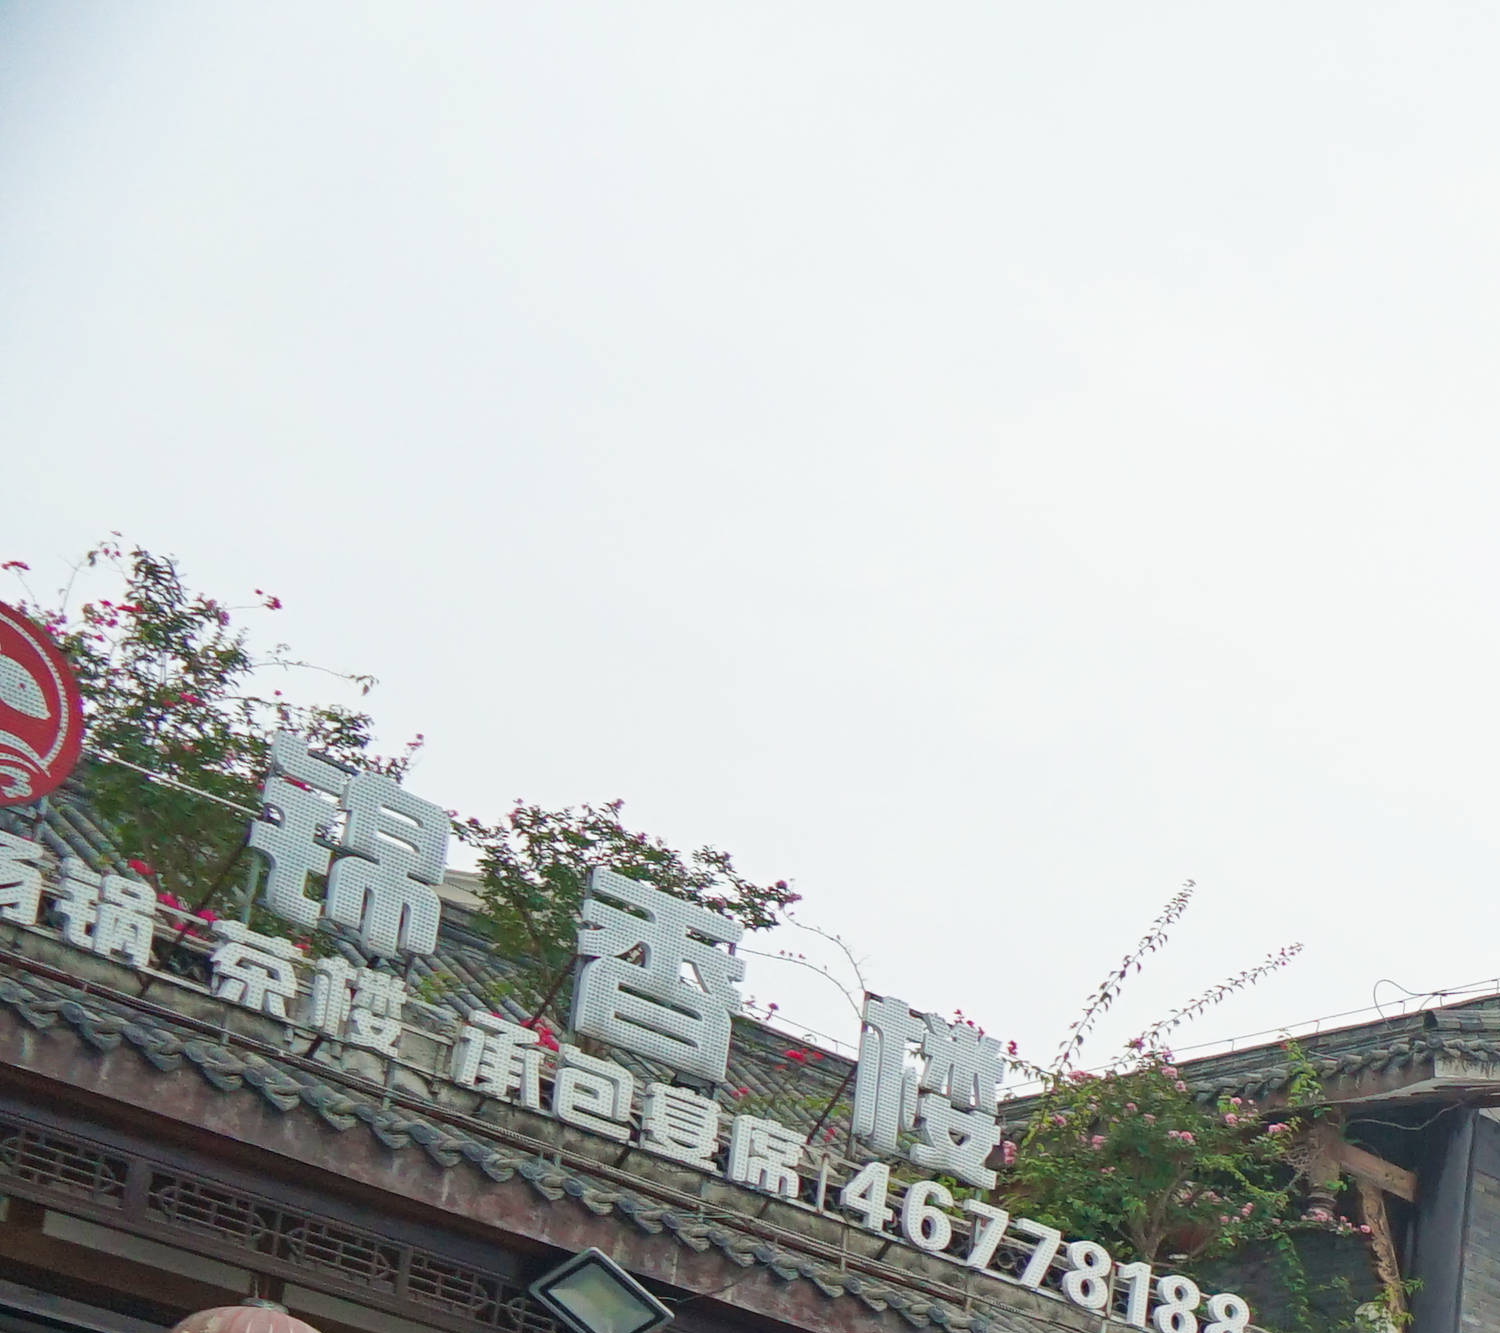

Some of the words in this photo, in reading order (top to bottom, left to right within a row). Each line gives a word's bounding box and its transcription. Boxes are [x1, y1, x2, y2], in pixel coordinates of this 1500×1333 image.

[249, 730, 1006, 1190] 锦香楼
[452, 1010, 808, 1199] 承包宴席
